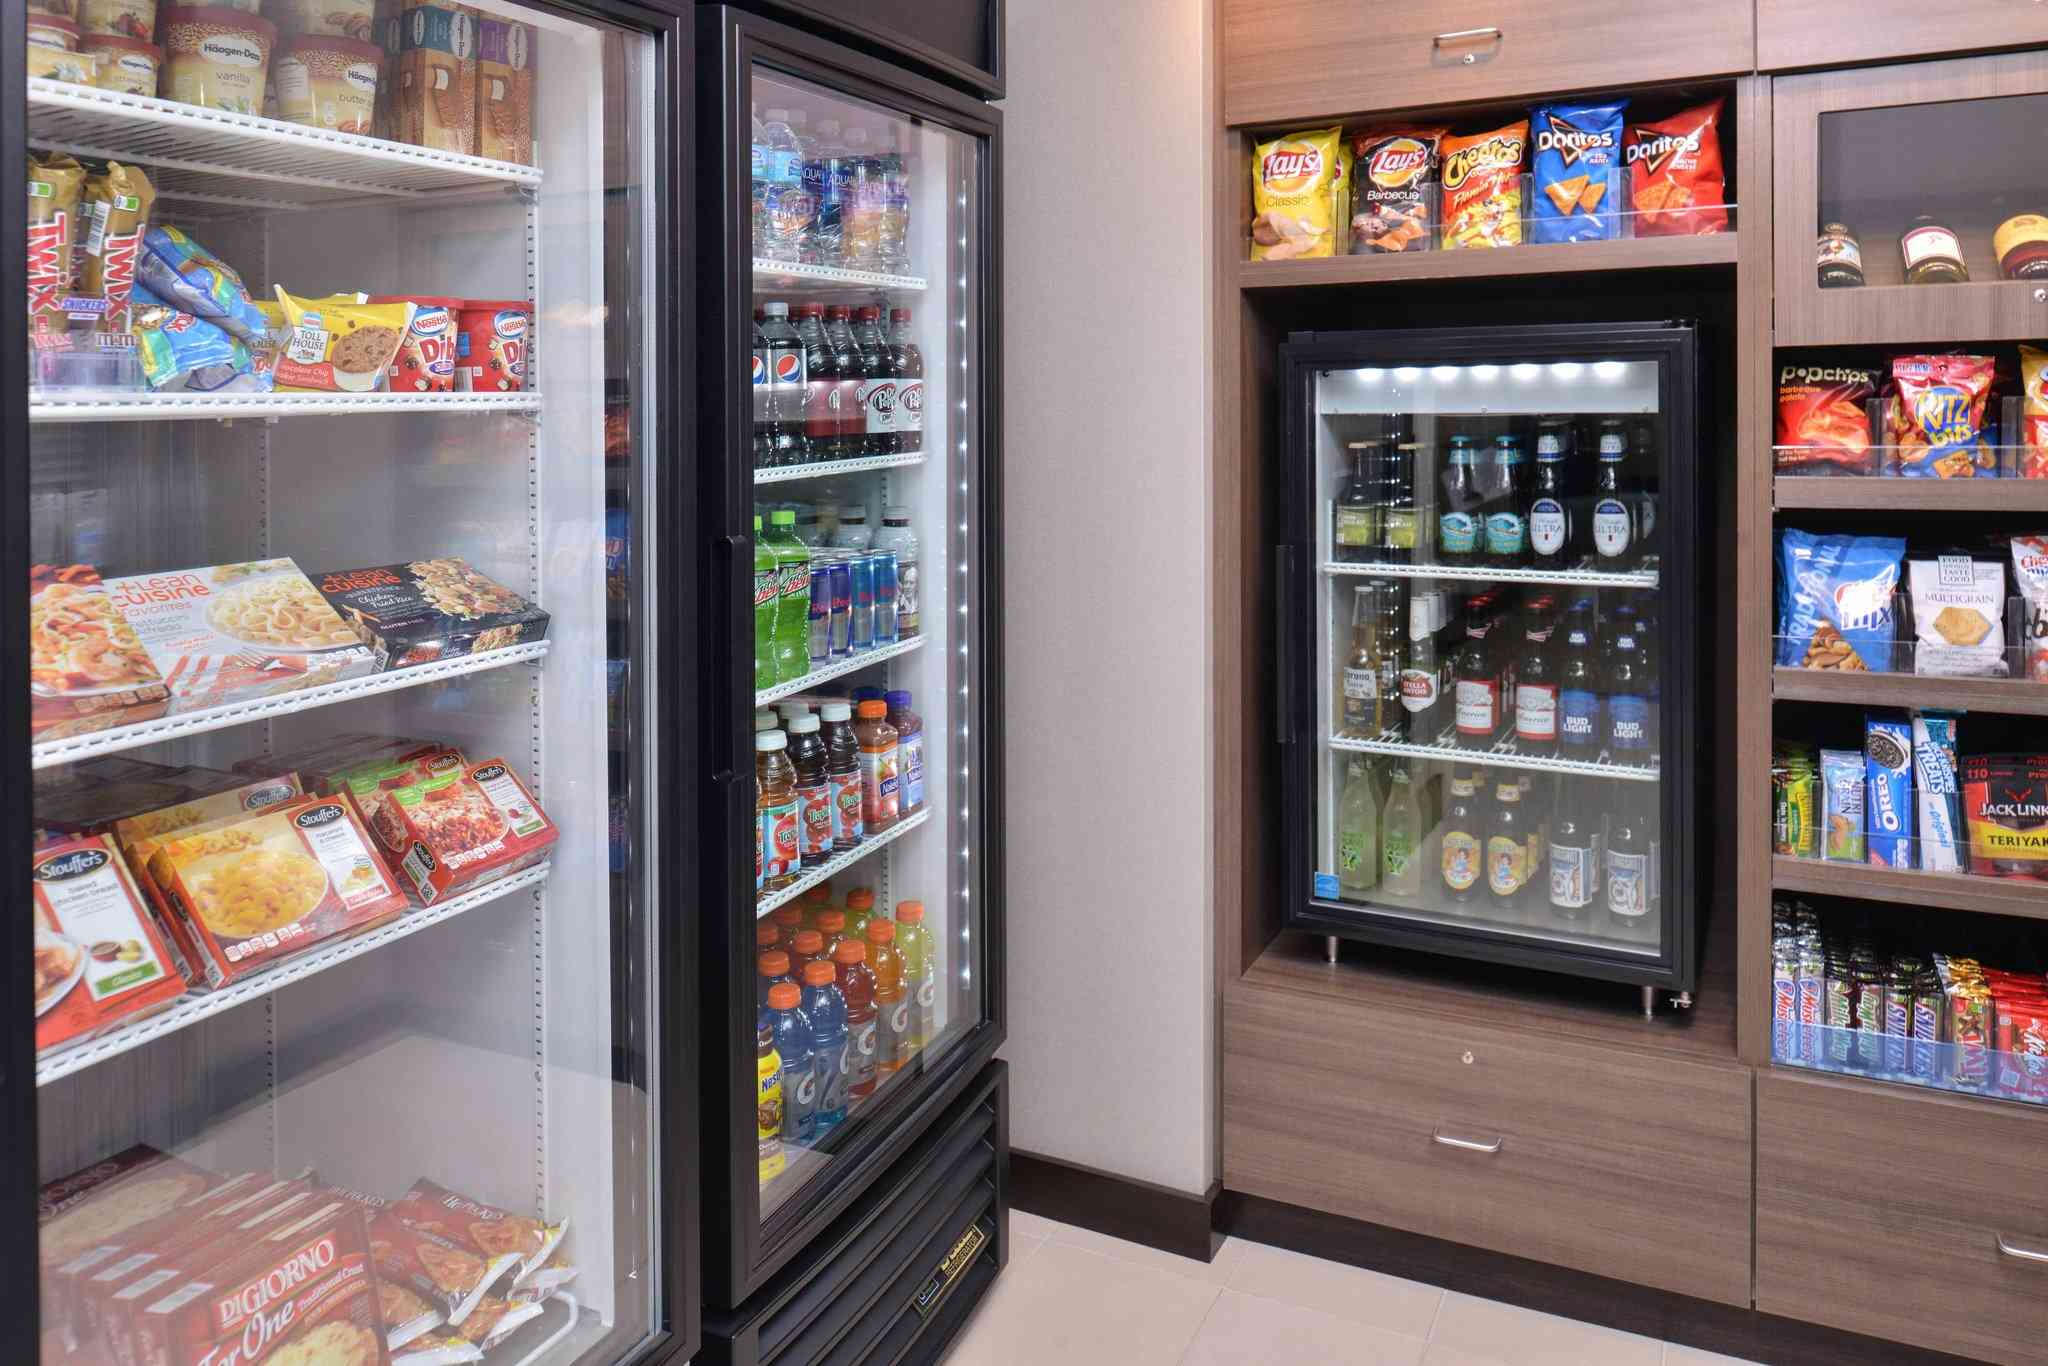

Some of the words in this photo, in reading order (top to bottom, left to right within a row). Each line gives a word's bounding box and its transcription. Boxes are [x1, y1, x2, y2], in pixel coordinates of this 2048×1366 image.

[1538, 131, 1613, 151] Doritos
[1627, 135, 1700, 163] Doritos
[1367, 189, 1420, 202] Barbecue
[28, 212, 67, 315] TWIX
[104, 223, 146, 321] TWIX
[293, 338, 325, 351] HOUSE
[301, 330, 321, 341] TOLL
[1924, 592, 1995, 604] MULTIGRAIN
[1563, 723, 1592, 733] LIGHT
[1566, 715, 1589, 725] BUD
[1616, 721, 1640, 730] BUD
[1613, 728, 1643, 739] LIGHT
[1914, 742, 1945, 794] TREATS
[1877, 773, 1900, 832] OREO
[1980, 803, 2016, 817] JACK
[300, 805, 341, 827] Stouffer's
[39, 851, 103, 880] Stouffer's
[219, 1239, 335, 1322] DIGIORNO
[243, 1299, 295, 1360] One
